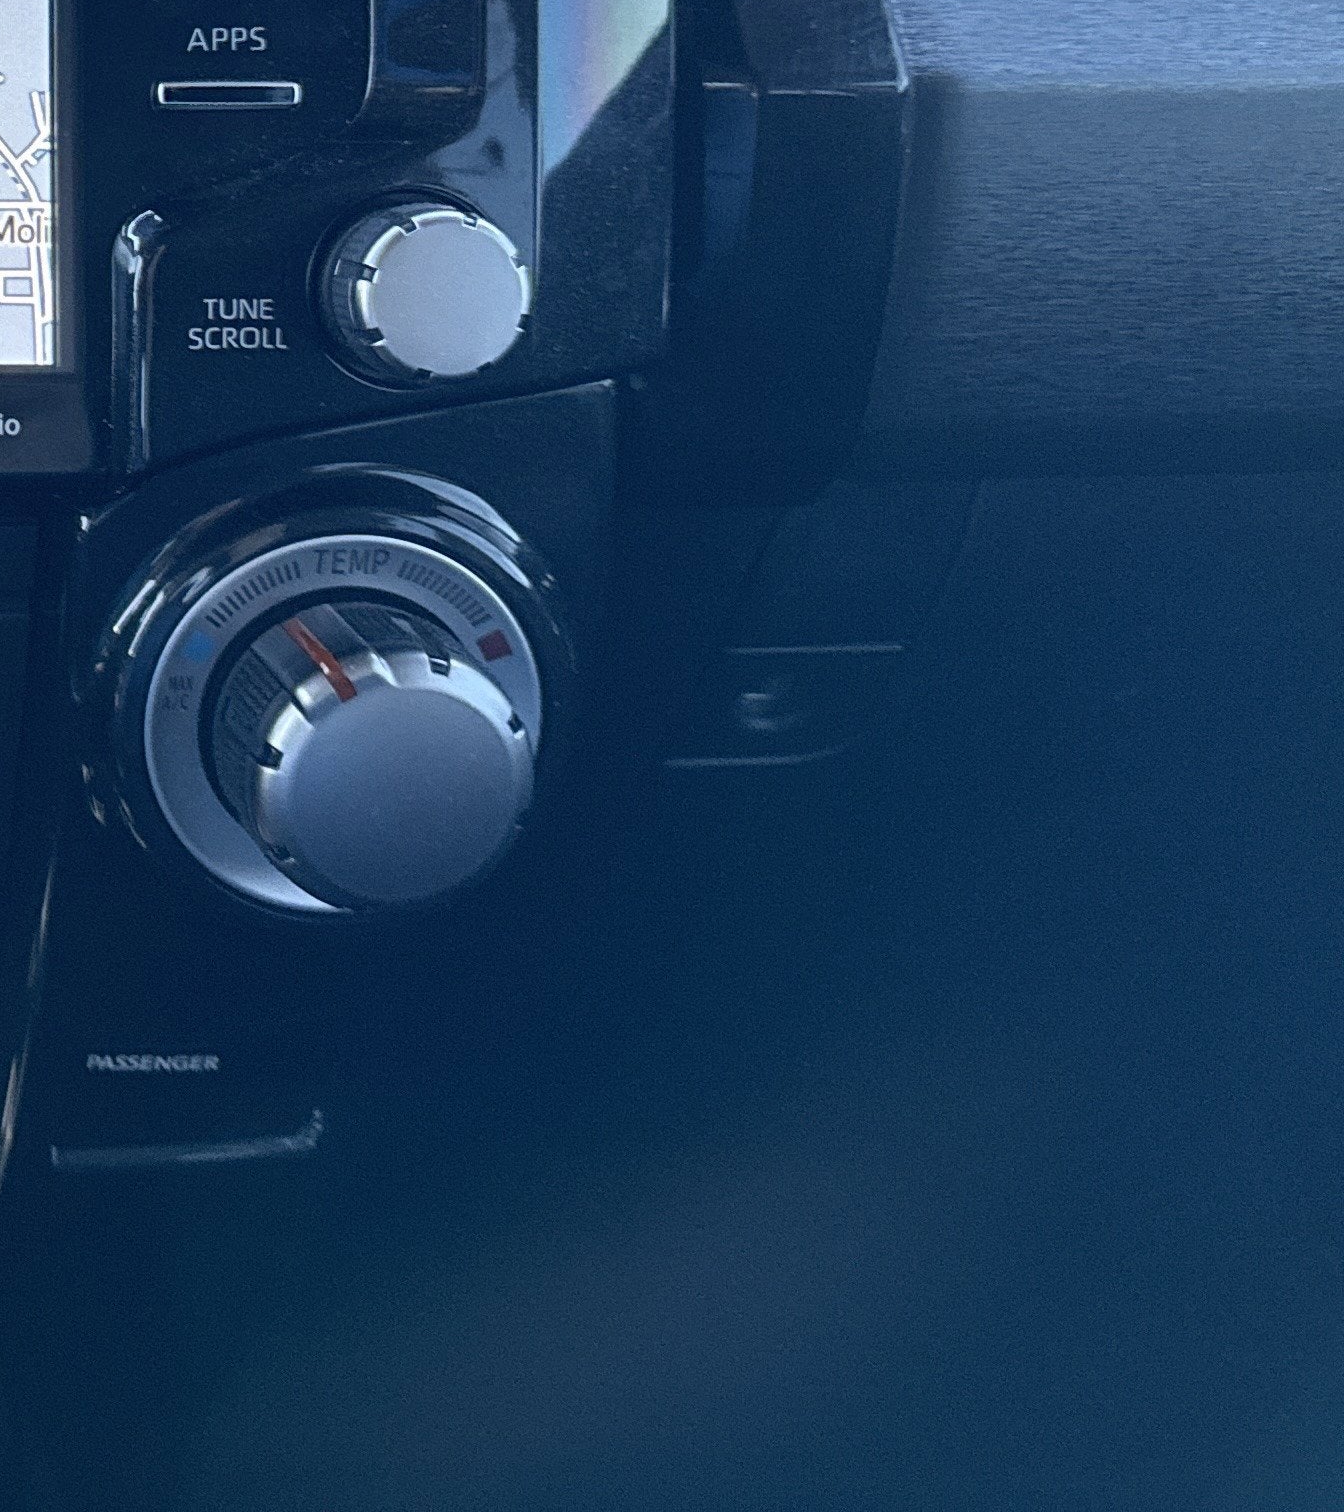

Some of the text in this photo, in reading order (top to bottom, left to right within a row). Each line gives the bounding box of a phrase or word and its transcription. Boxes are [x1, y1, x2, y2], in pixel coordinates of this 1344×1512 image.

[186, 26, 268, 52] APPS
[203, 298, 275, 321] TUNE
[187, 326, 288, 351] SCROLL
[312, 548, 392, 576] TEMP
[86, 1053, 220, 1073] PASSENGER
